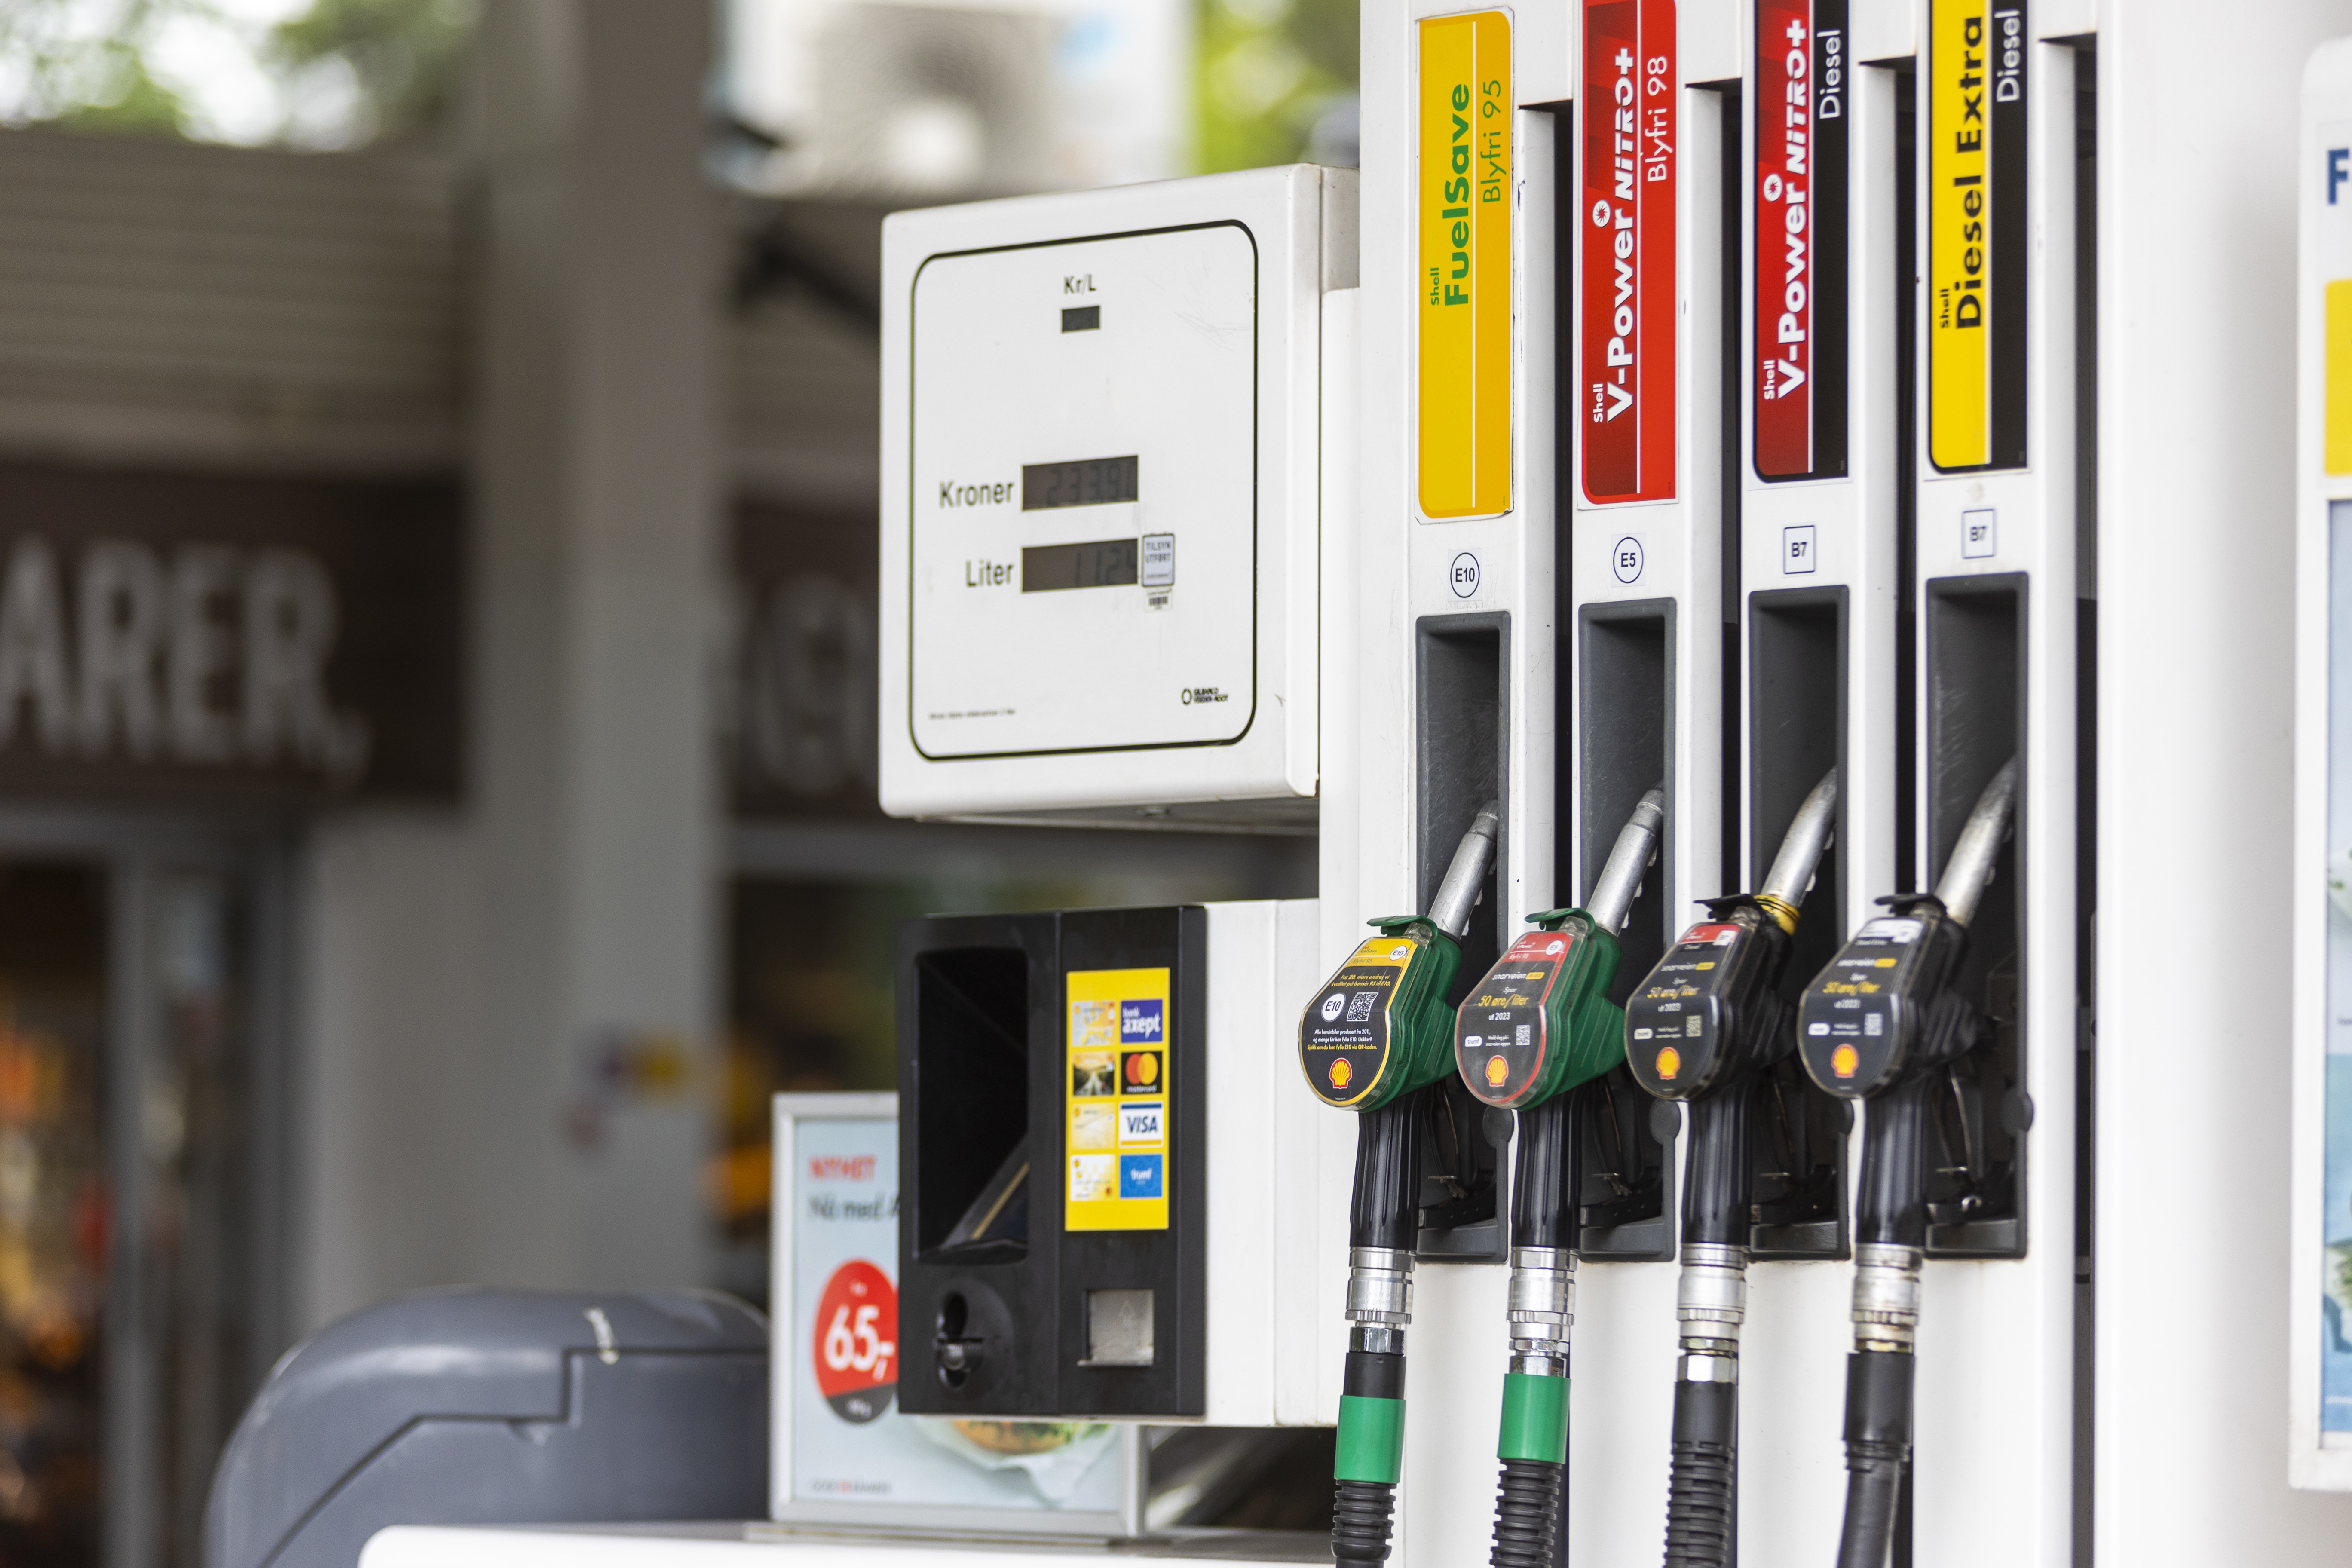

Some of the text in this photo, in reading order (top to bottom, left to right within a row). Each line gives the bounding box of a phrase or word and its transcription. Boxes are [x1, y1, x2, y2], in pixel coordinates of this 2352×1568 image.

[1994, 10, 2020, 102] Diesel
[1817, 30, 1841, 119] Diesel
[1645, 56, 1672, 182] Blyfri 98
[1481, 80, 1506, 203] Blyfri 95
[1953, 17, 1982, 329] Diesel Extra
[1442, 84, 1470, 306] FuelSave
[1064, 274, 1097, 294] Kr/L
[1430, 267, 1439, 306] Shell
[1778, 182, 1806, 399] V-Power
[1608, 207, 1633, 423] V-Power
[1939, 288, 1949, 329] Shell
[1764, 360, 1775, 400] Shell
[1593, 383, 1603, 423] Shell
[940, 481, 1014, 508] Kroner
[1792, 542, 1807, 557] B7
[1970, 526, 1987, 542] B7
[966, 560, 1014, 587] Liter
[1455, 567, 1475, 582] E10
[1621, 553, 1635, 567] E5
[1492, 972, 1527, 980] snarveien
[1325, 1001, 1341, 1011] E10
[1478, 995, 1492, 1007] 50
[1123, 1012, 1160, 1038] axept
[1127, 1116, 1158, 1133] VISA
